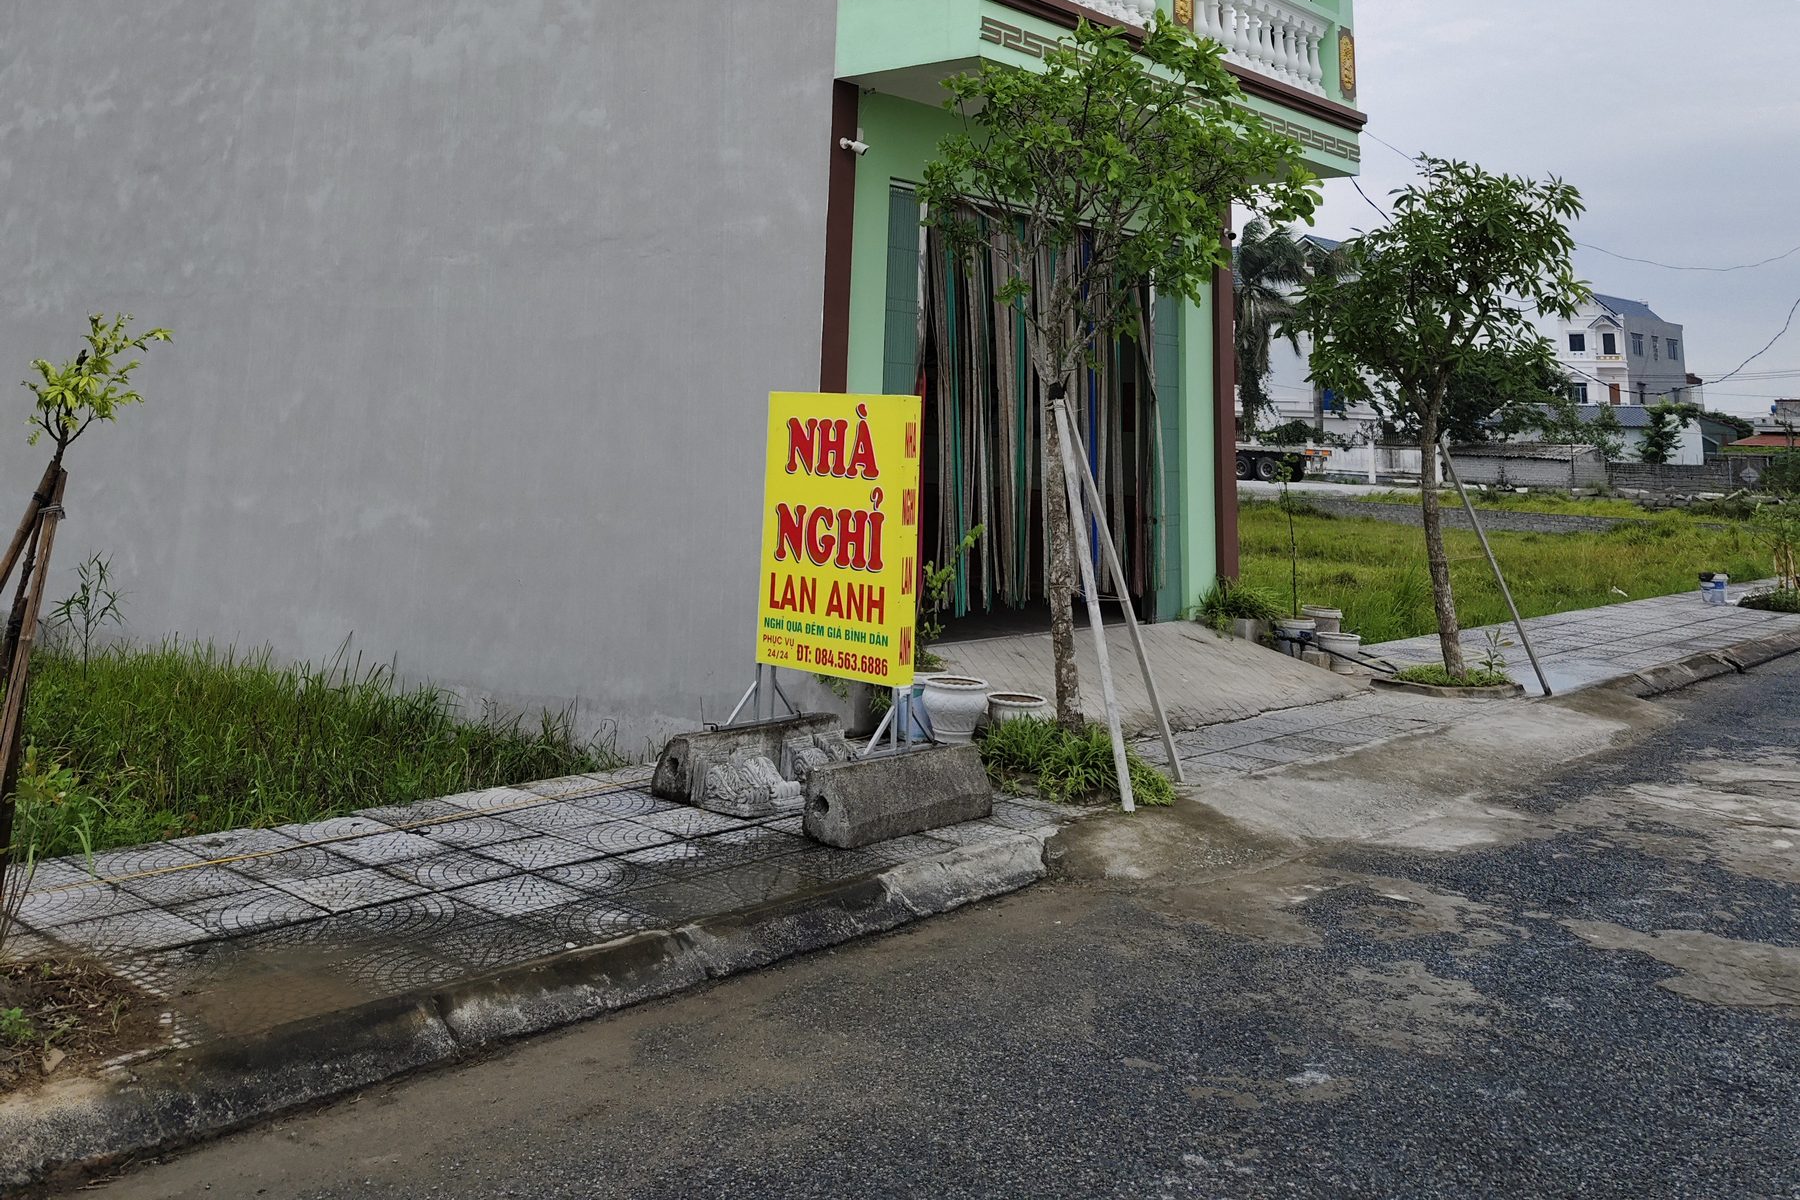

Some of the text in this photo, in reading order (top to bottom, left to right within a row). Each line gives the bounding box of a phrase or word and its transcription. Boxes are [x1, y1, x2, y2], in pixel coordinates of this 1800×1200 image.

[785, 402, 880, 480] NHÀ
[774, 486, 885, 572] NGHỈ
[901, 557, 913, 595] LAN
[769, 572, 885, 625] LAN ANH
[763, 634, 794, 650] PHỤC VỤ
[764, 615, 888, 647] NGHỈ QUA ĐÊM GIÁ BÌNH DÂN
[899, 626, 911, 666] ANH
[767, 648, 788, 660] 24/24
[797, 644, 888, 676] ĐT: 084.563.6886
